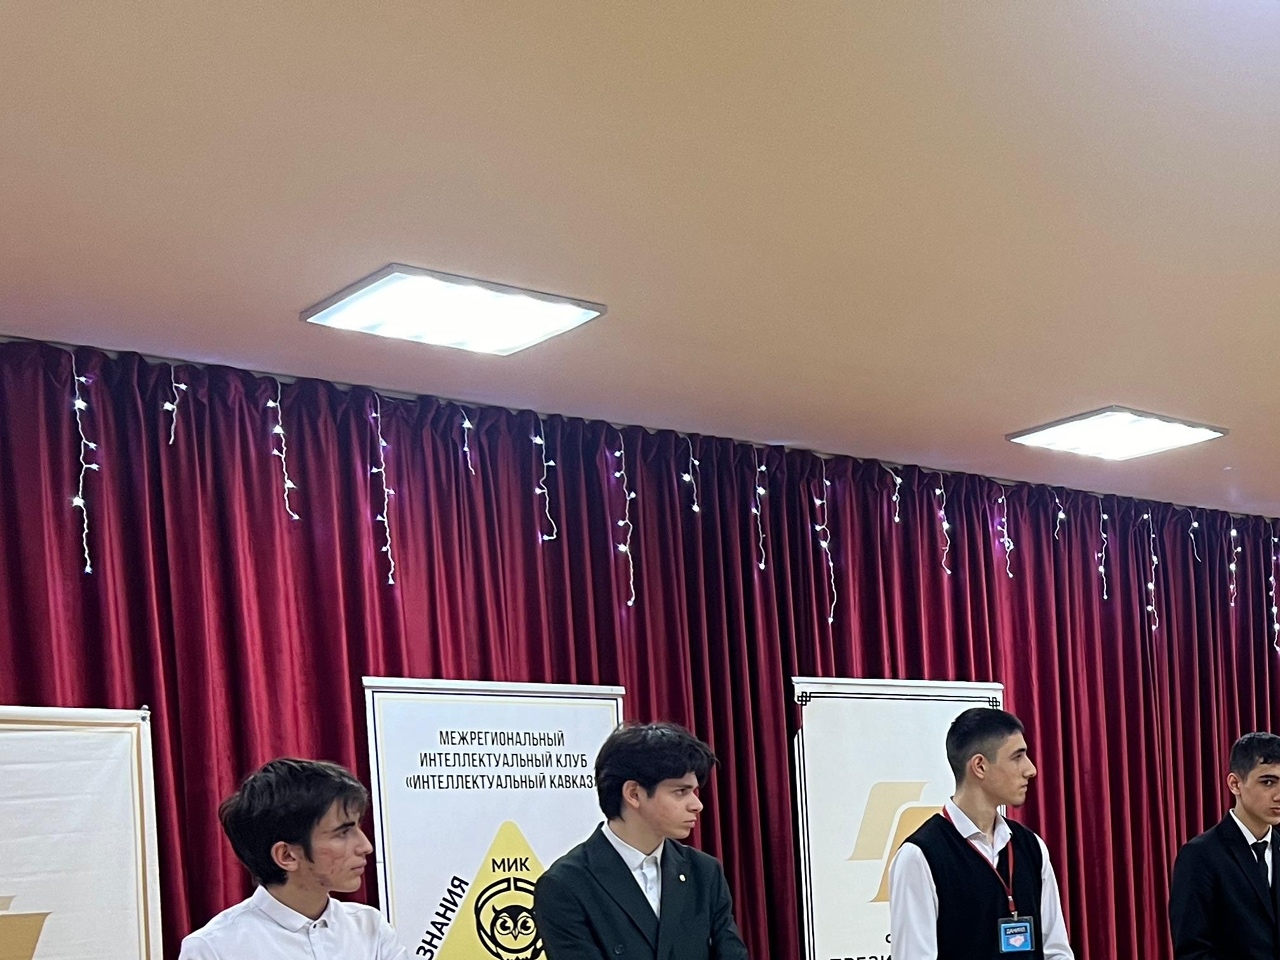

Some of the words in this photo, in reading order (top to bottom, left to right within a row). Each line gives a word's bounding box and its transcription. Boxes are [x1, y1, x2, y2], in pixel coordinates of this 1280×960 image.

[439, 730, 565, 747] МЕЖРЕГИОНАЛЬНЫЙ
[419, 751, 553, 768] ИНТЕЛЛЕКТУАЛЬНЫЙ
[556, 753, 588, 768] КЛУБ
[405, 773, 547, 790] «ИНТЕЛЛЕКТУАЛЬНЫЙ
[491, 857, 531, 873] МИК
